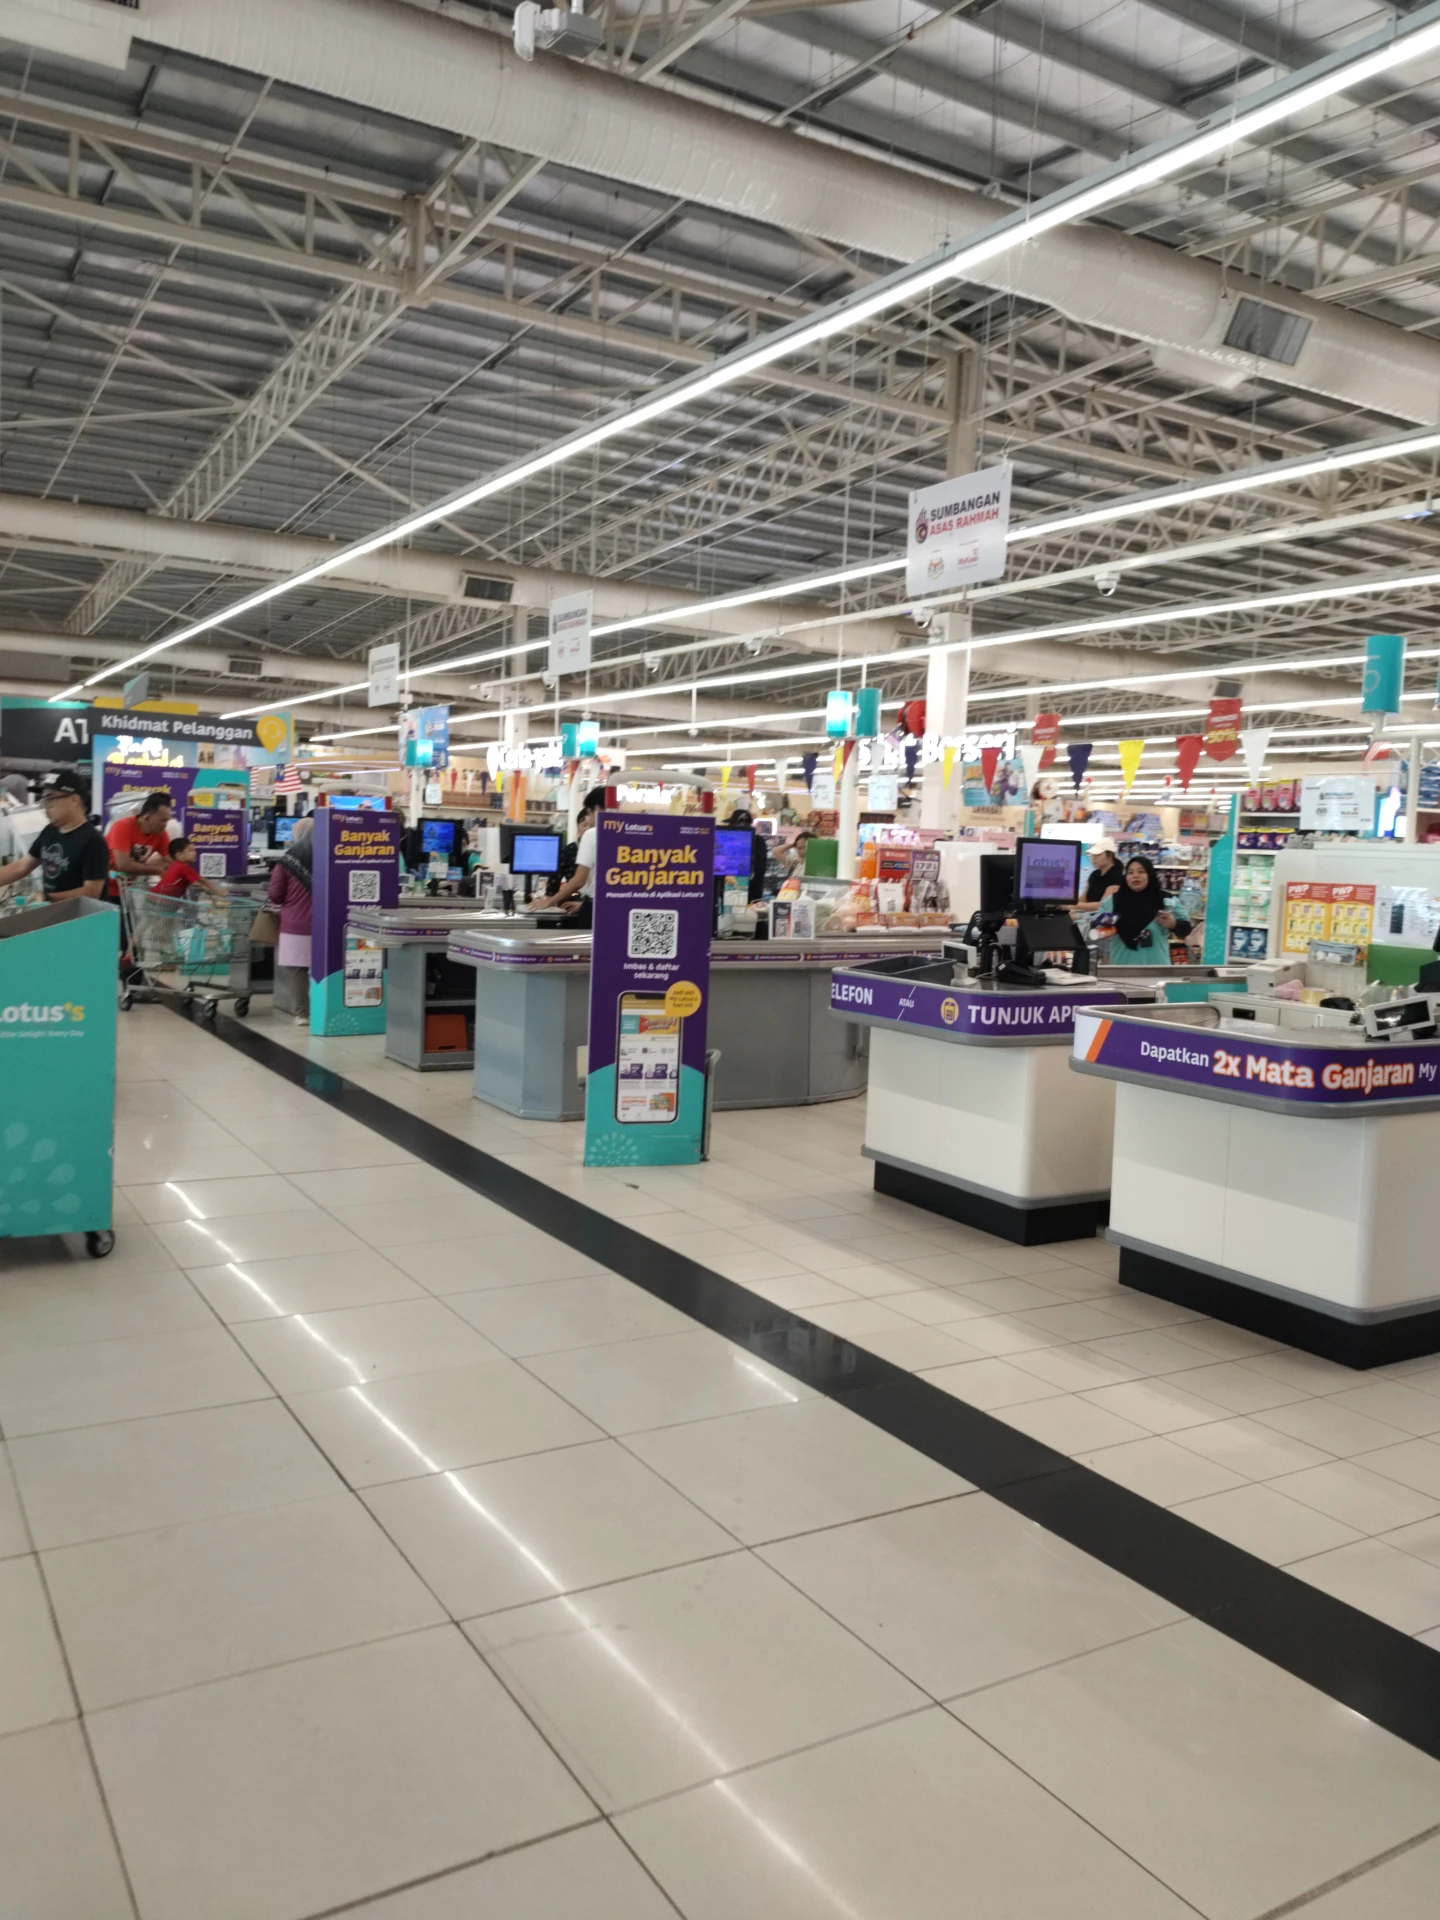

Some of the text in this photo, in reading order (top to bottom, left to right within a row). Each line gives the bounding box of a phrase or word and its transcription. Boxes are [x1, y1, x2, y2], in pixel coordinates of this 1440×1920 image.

[930, 491, 1001, 522] SUMBANGAN
[929, 507, 1000, 536] ASAS RAHMAH
[101, 714, 253, 741] Khidmat Pelanggan
[193, 823, 235, 834] Banyak
[603, 819, 654, 833] my Lotus's
[188, 834, 239, 845] Ganjaran
[341, 829, 390, 845] Banyak
[334, 843, 395, 859] Ganjaran
[616, 845, 698, 869] Banyak
[605, 865, 705, 891] Ganjaran
[1288, 884, 1310, 894] PWP
[1332, 885, 1354, 896] PWP
[655, 963, 680, 971] daftar
[633, 971, 669, 981] sekarang
[0, 1002, 87, 1023] otus's
[898, 997, 915, 1009] ATAU
[968, 1004, 1044, 1025] TUNJUK
[1140, 1041, 1438, 1095] Dapatkan 2x Mata Ganjaran My
